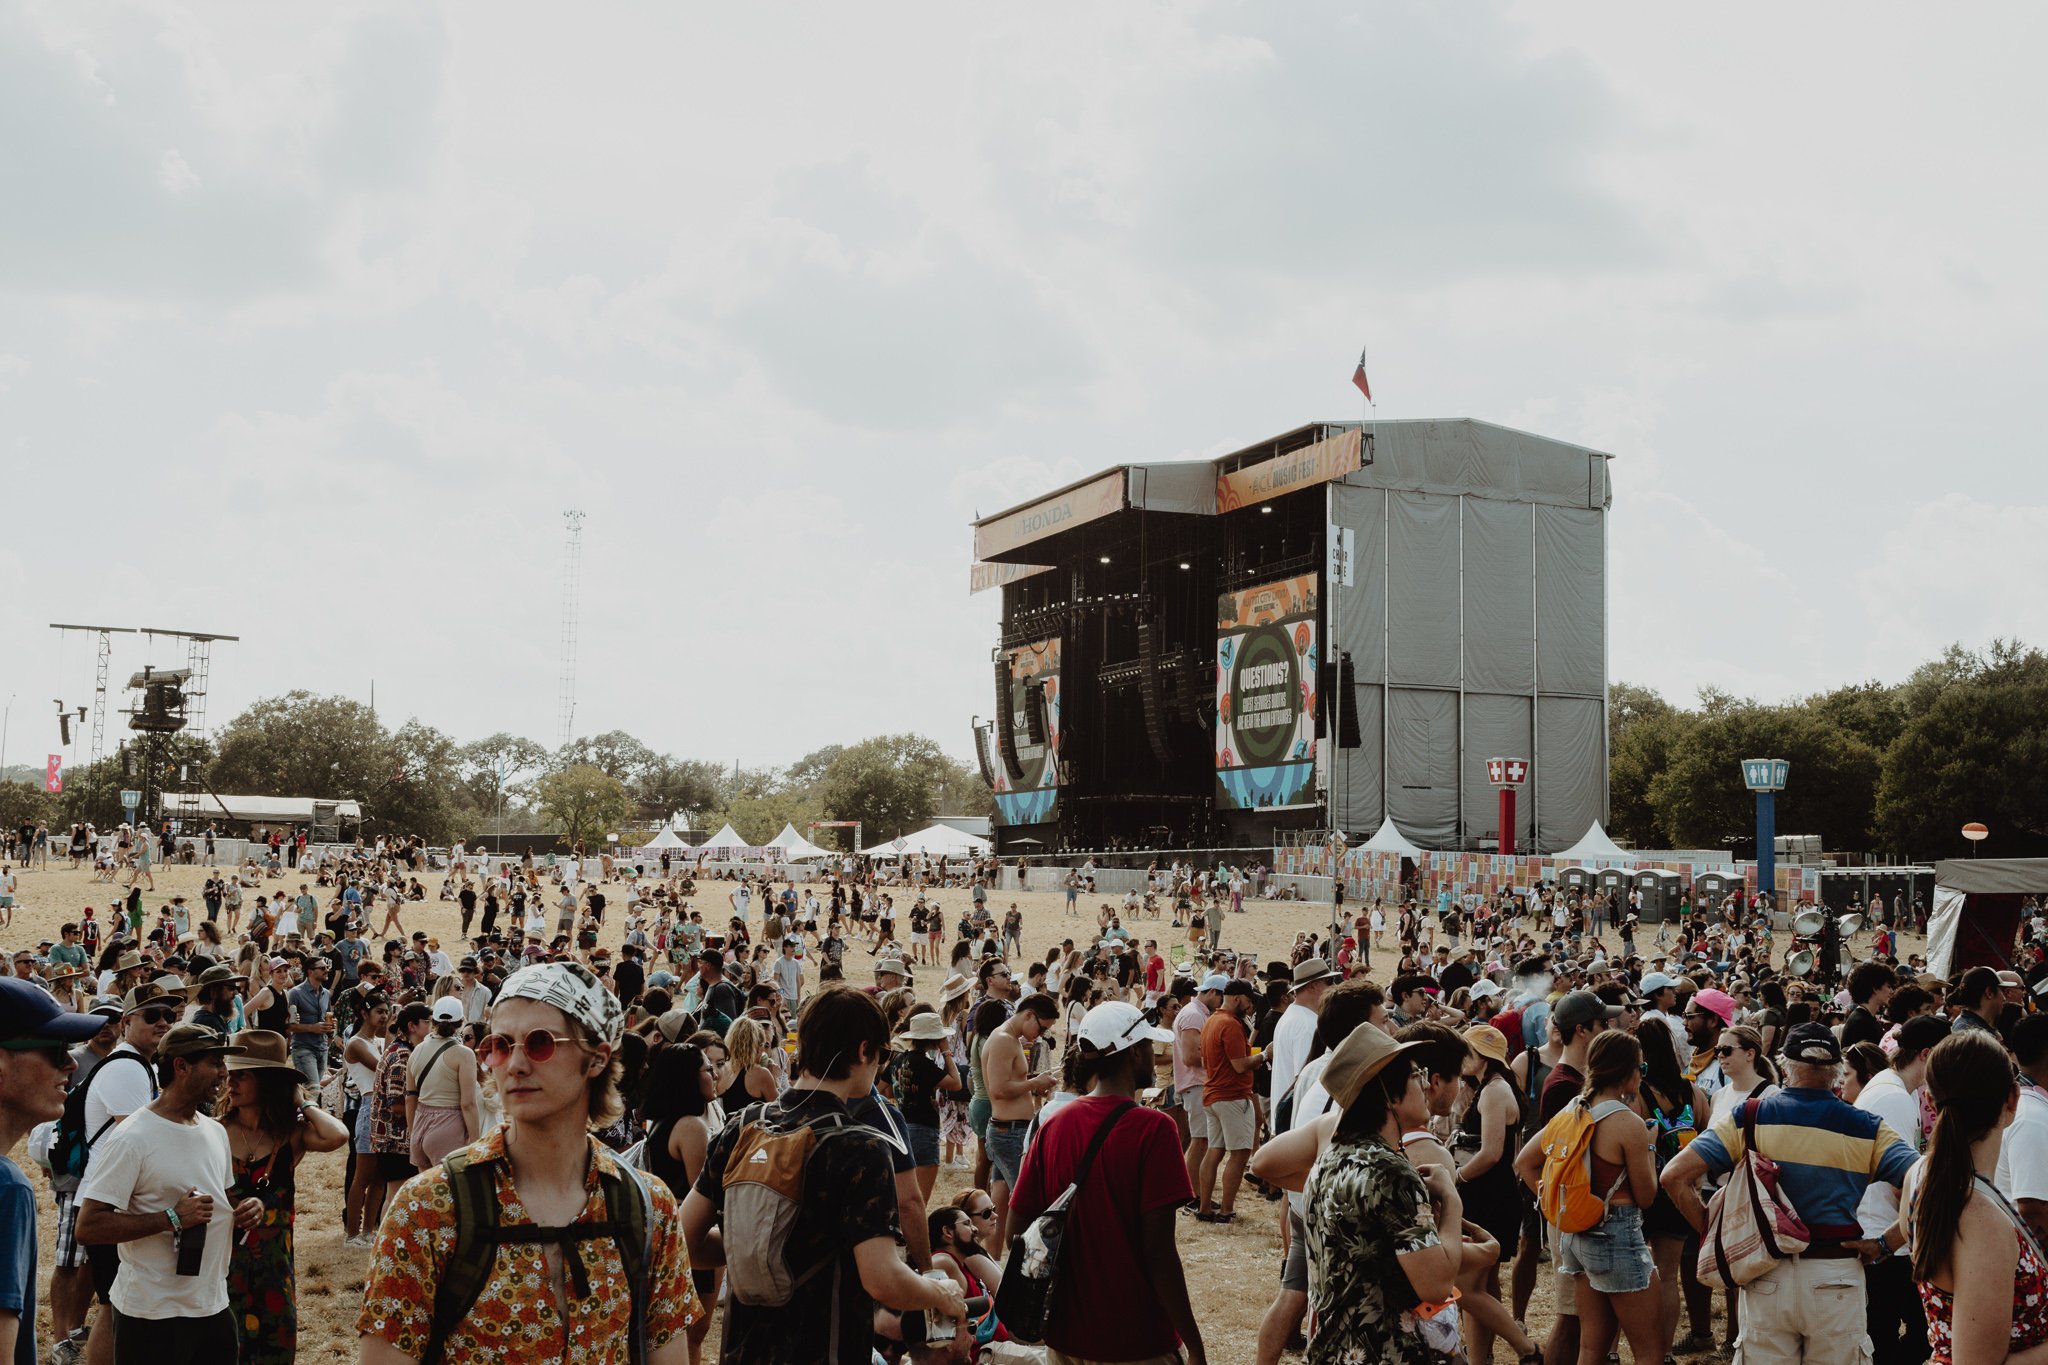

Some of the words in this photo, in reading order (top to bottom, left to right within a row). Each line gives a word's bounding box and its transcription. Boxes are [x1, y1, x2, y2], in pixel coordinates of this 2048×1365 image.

[1252, 474, 1272, 495] ACL
[1273, 465, 1297, 488] MUSIC
[1298, 458, 1316, 481] FEST
[1022, 503, 1072, 534] HONDA
[1332, 548, 1348, 562] CHR
[1333, 563, 1347, 577] ZOE
[1240, 661, 1290, 692] QUESTIONS?
